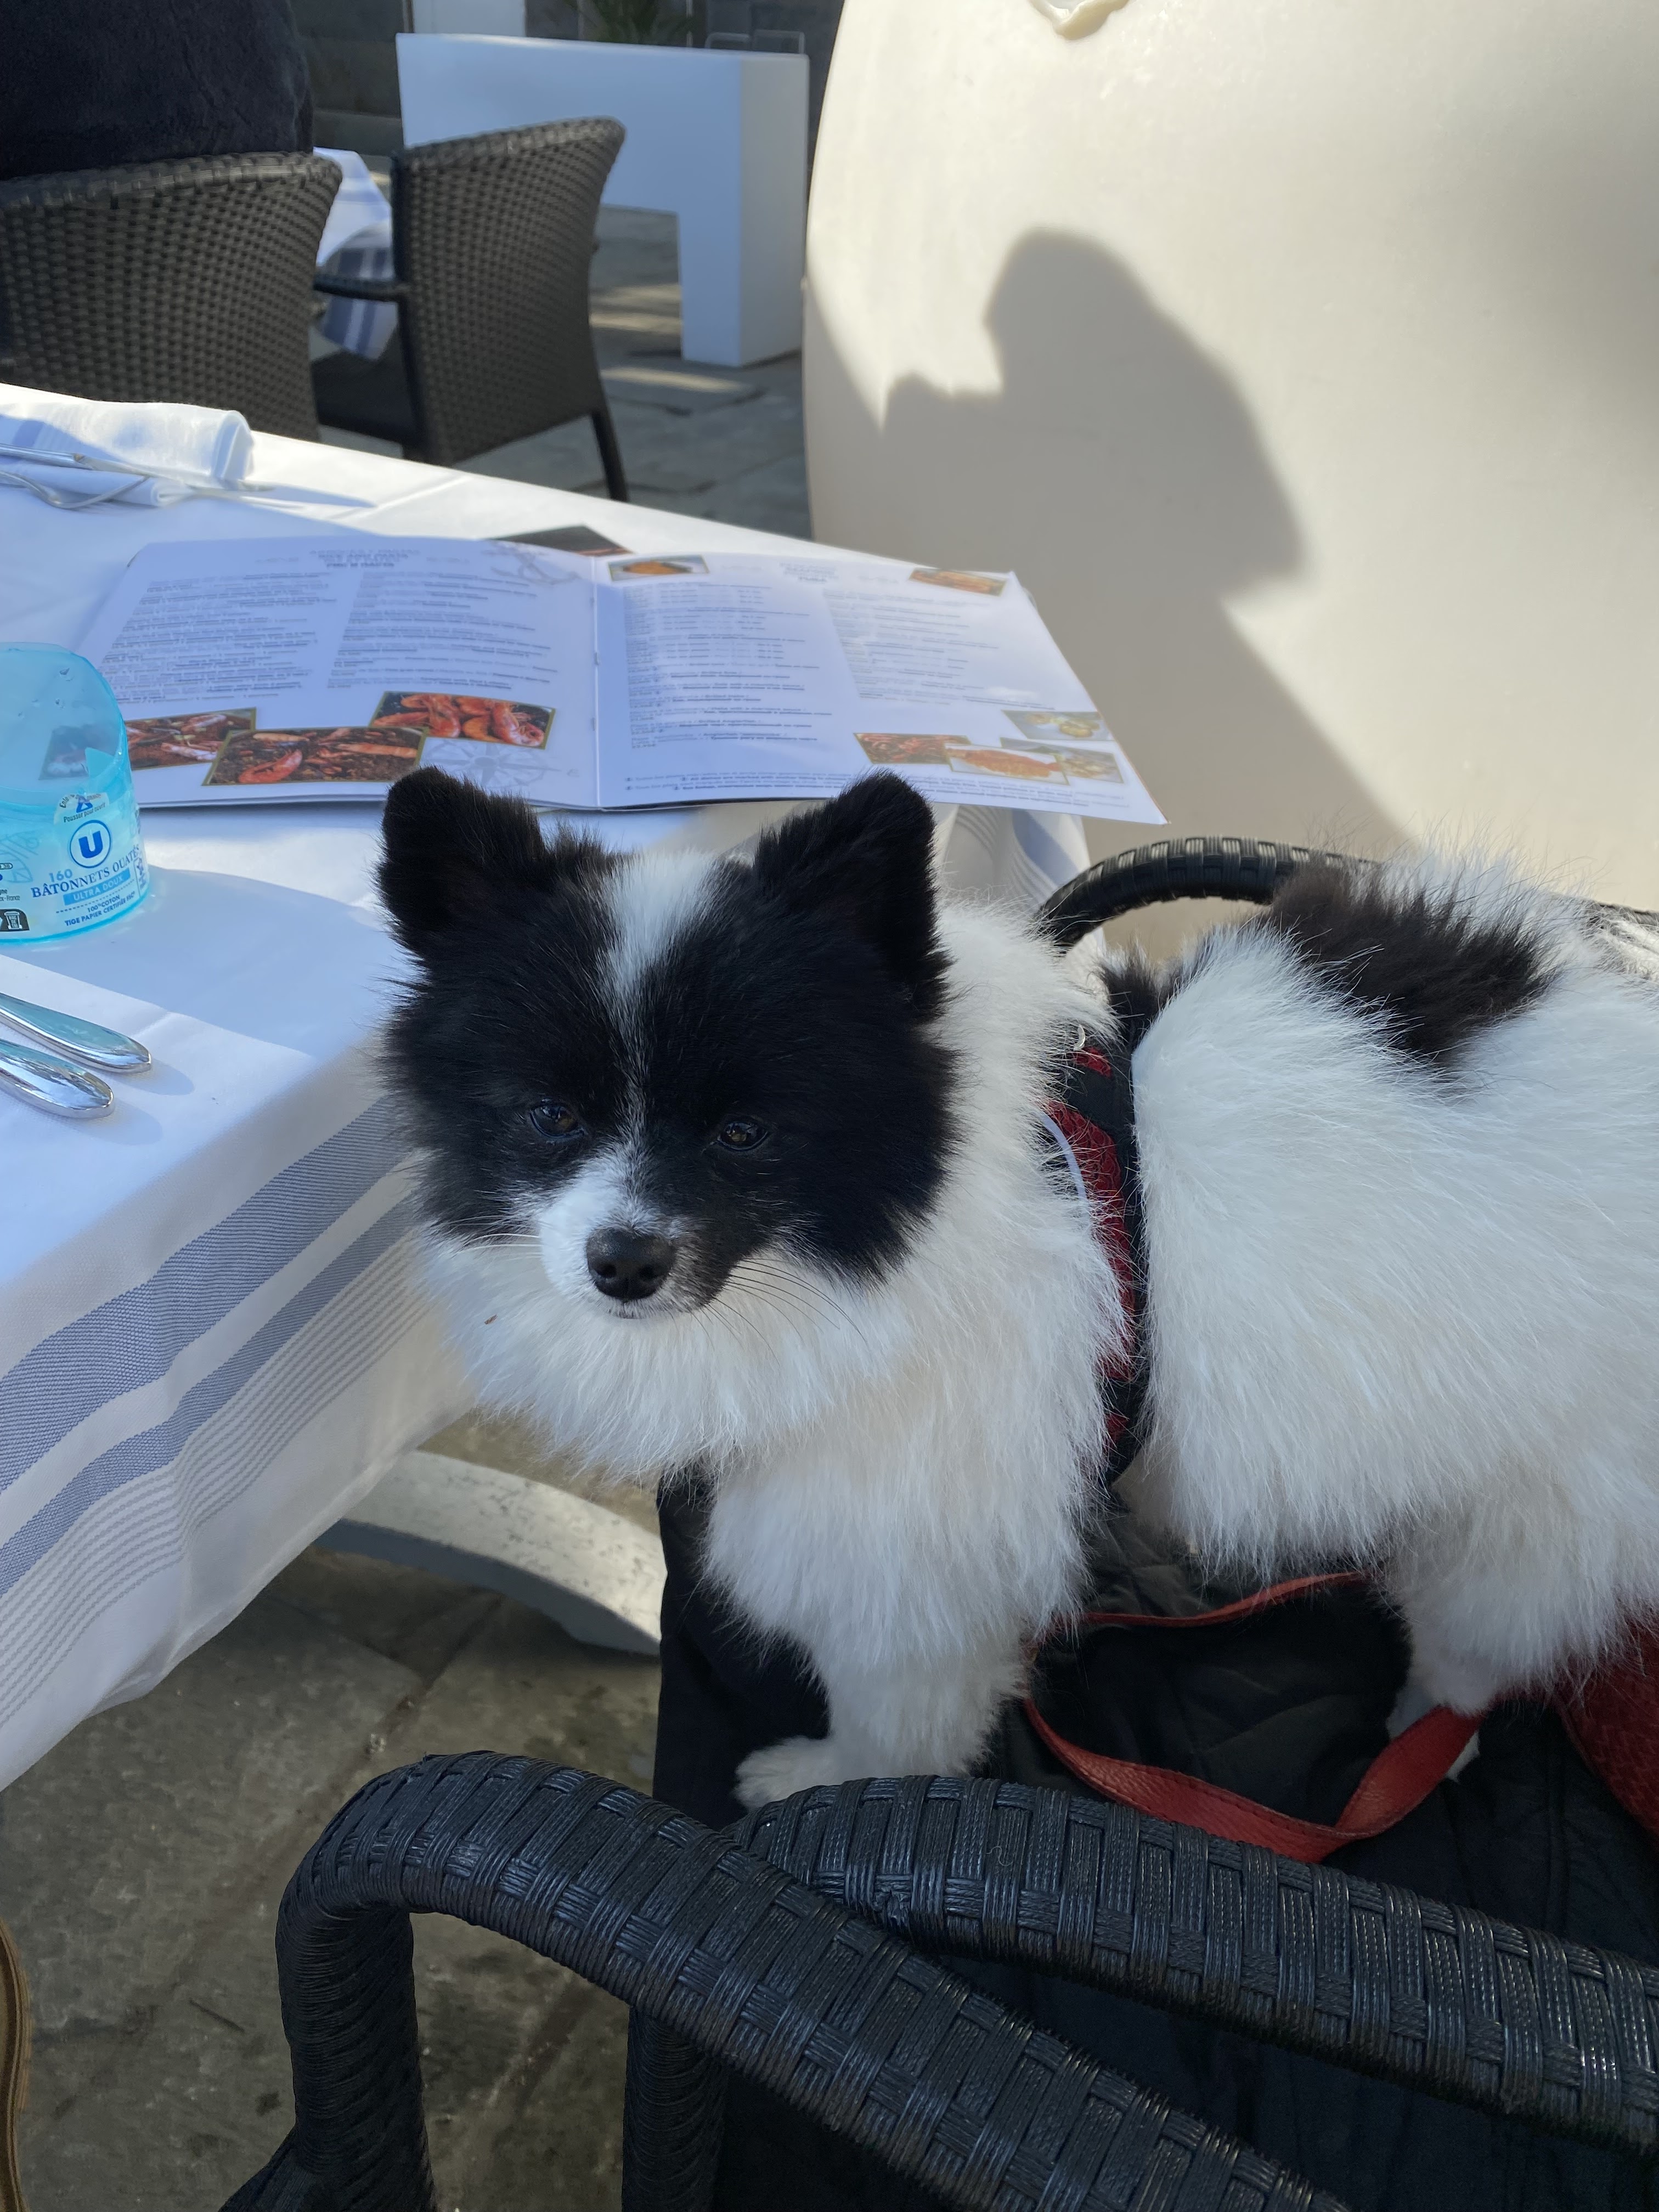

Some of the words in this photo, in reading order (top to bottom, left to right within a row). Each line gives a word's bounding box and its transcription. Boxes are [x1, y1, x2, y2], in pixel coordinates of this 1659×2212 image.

[78, 831, 103, 859] U
[31, 867, 110, 898] BÂTONNETS
[49, 869, 73, 883] 160
[73, 887, 101, 901] ULTRA
[103, 874, 123, 891] DOUX
[101, 894, 121, 907] COTON
[64, 917, 80, 927] TIGE
[81, 911, 102, 922] PAPIER
